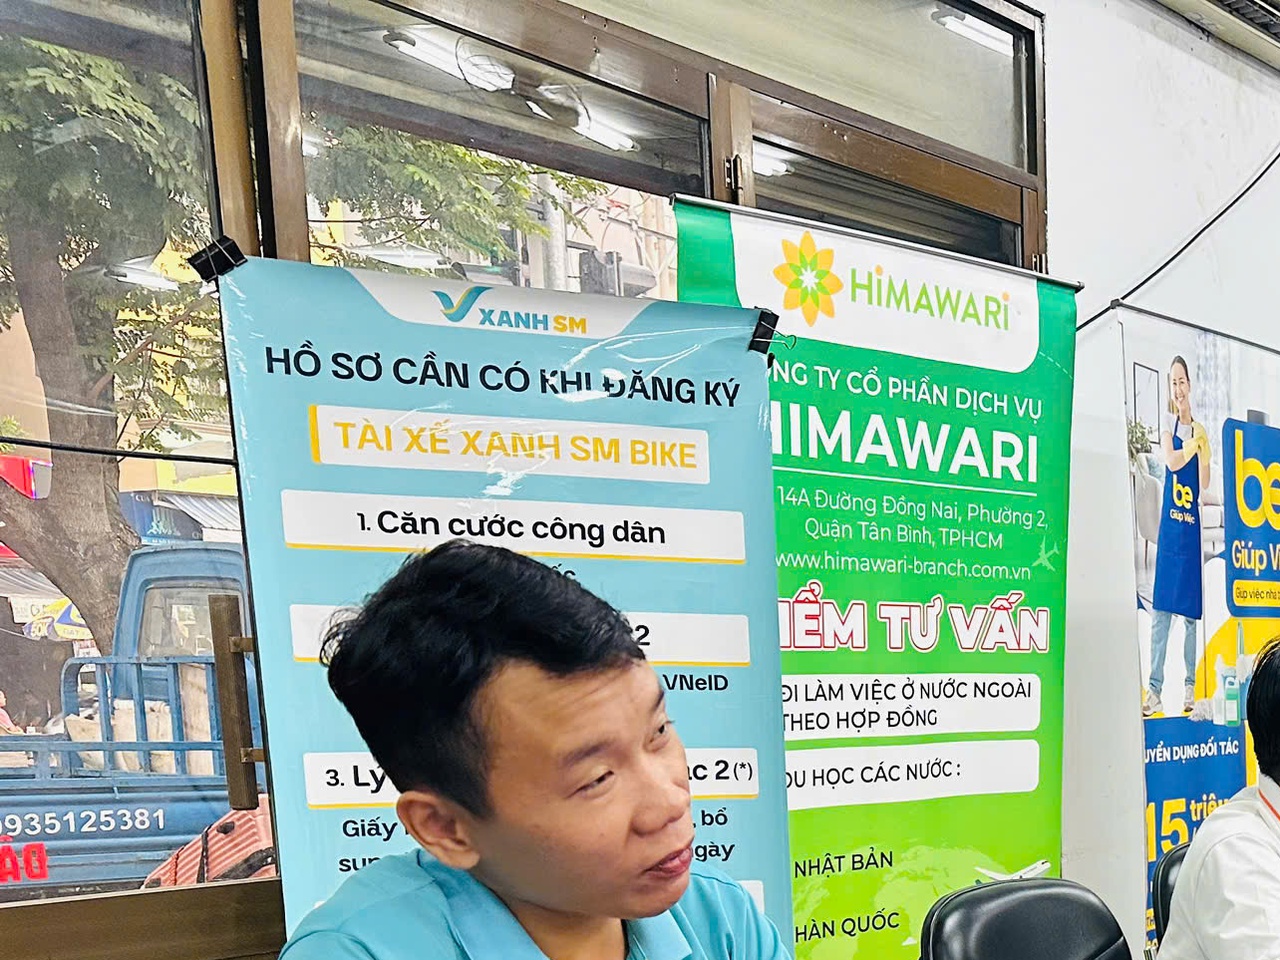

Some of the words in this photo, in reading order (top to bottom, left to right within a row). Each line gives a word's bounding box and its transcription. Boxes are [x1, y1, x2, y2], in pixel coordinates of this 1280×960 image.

[478, 307, 549, 332] XANH
[552, 314, 588, 335] SM
[265, 340, 321, 378] HỒ
[331, 350, 382, 383] SƠ
[392, 349, 470, 390] CẦN
[478, 358, 530, 393] CÓ
[539, 369, 591, 398] KHI
[603, 369, 696, 405] ĐĂNG
[703, 376, 741, 408] KÝ
[813, 365, 842, 391] TY
[846, 366, 882, 396] CỔ
[888, 374, 948, 407] PHẦN
[955, 388, 1008, 417] DỊCH
[1013, 395, 1042, 425] VỤ
[333, 418, 394, 453] TÀI
[402, 418, 451, 455] XẾ
[460, 428, 561, 461] XANH
[569, 437, 620, 463] SM
[629, 441, 698, 469] BIKE
[1172, 473, 1194, 510] be
[777, 486, 811, 507] 14A
[814, 489, 877, 517] Đường
[882, 495, 927, 521] Đồng
[931, 500, 962, 524] Nai,
[967, 503, 1033, 530] Phường
[1036, 509, 1049, 531] 2,
[356, 511, 372, 532] 1.
[376, 508, 439, 536] Căn
[448, 508, 524, 540] cước
[531, 512, 605, 548] công
[612, 516, 666, 545] dân
[804, 517, 853, 543] Quận
[857, 519, 891, 542] Tân
[897, 523, 936, 548] Bình,
[938, 527, 1003, 550] TPHCM
[775, 550, 1031, 581] www.himawari-branch.com.vn
[1231, 539, 1267, 577] Giúp
[877, 593, 943, 653] TƯ
[947, 589, 1050, 653] VẤN
[661, 673, 729, 693] VNeID
[803, 678, 845, 702] LÀM
[850, 678, 896, 705] VIỆC
[901, 676, 915, 700] Ở
[920, 677, 968, 699] NƯỚC
[972, 677, 1032, 699] NGOÀI
[782, 712, 831, 732] THEO
[836, 707, 881, 733] HỢP
[886, 704, 937, 728] ĐỒNG
[1172, 743, 1200, 764] DỤNG
[1200, 735, 1218, 758] ĐỐI
[1219, 736, 1240, 756] TÁC
[325, 768, 346, 788] 3.
[812, 766, 855, 790] HỌC
[860, 761, 901, 784] CÁC
[906, 757, 953, 781] NƯỚC
[0, 807, 165, 837] 935125381
[342, 816, 398, 842] Giấy
[701, 807, 729, 826] bổ
[1145, 797, 1190, 863] 15
[692, 841, 735, 862] gày
[794, 852, 846, 879] NHẬT
[851, 846, 893, 871] BẢN
[795, 918, 835, 943] HÀN
[841, 907, 900, 938] QUỐC
